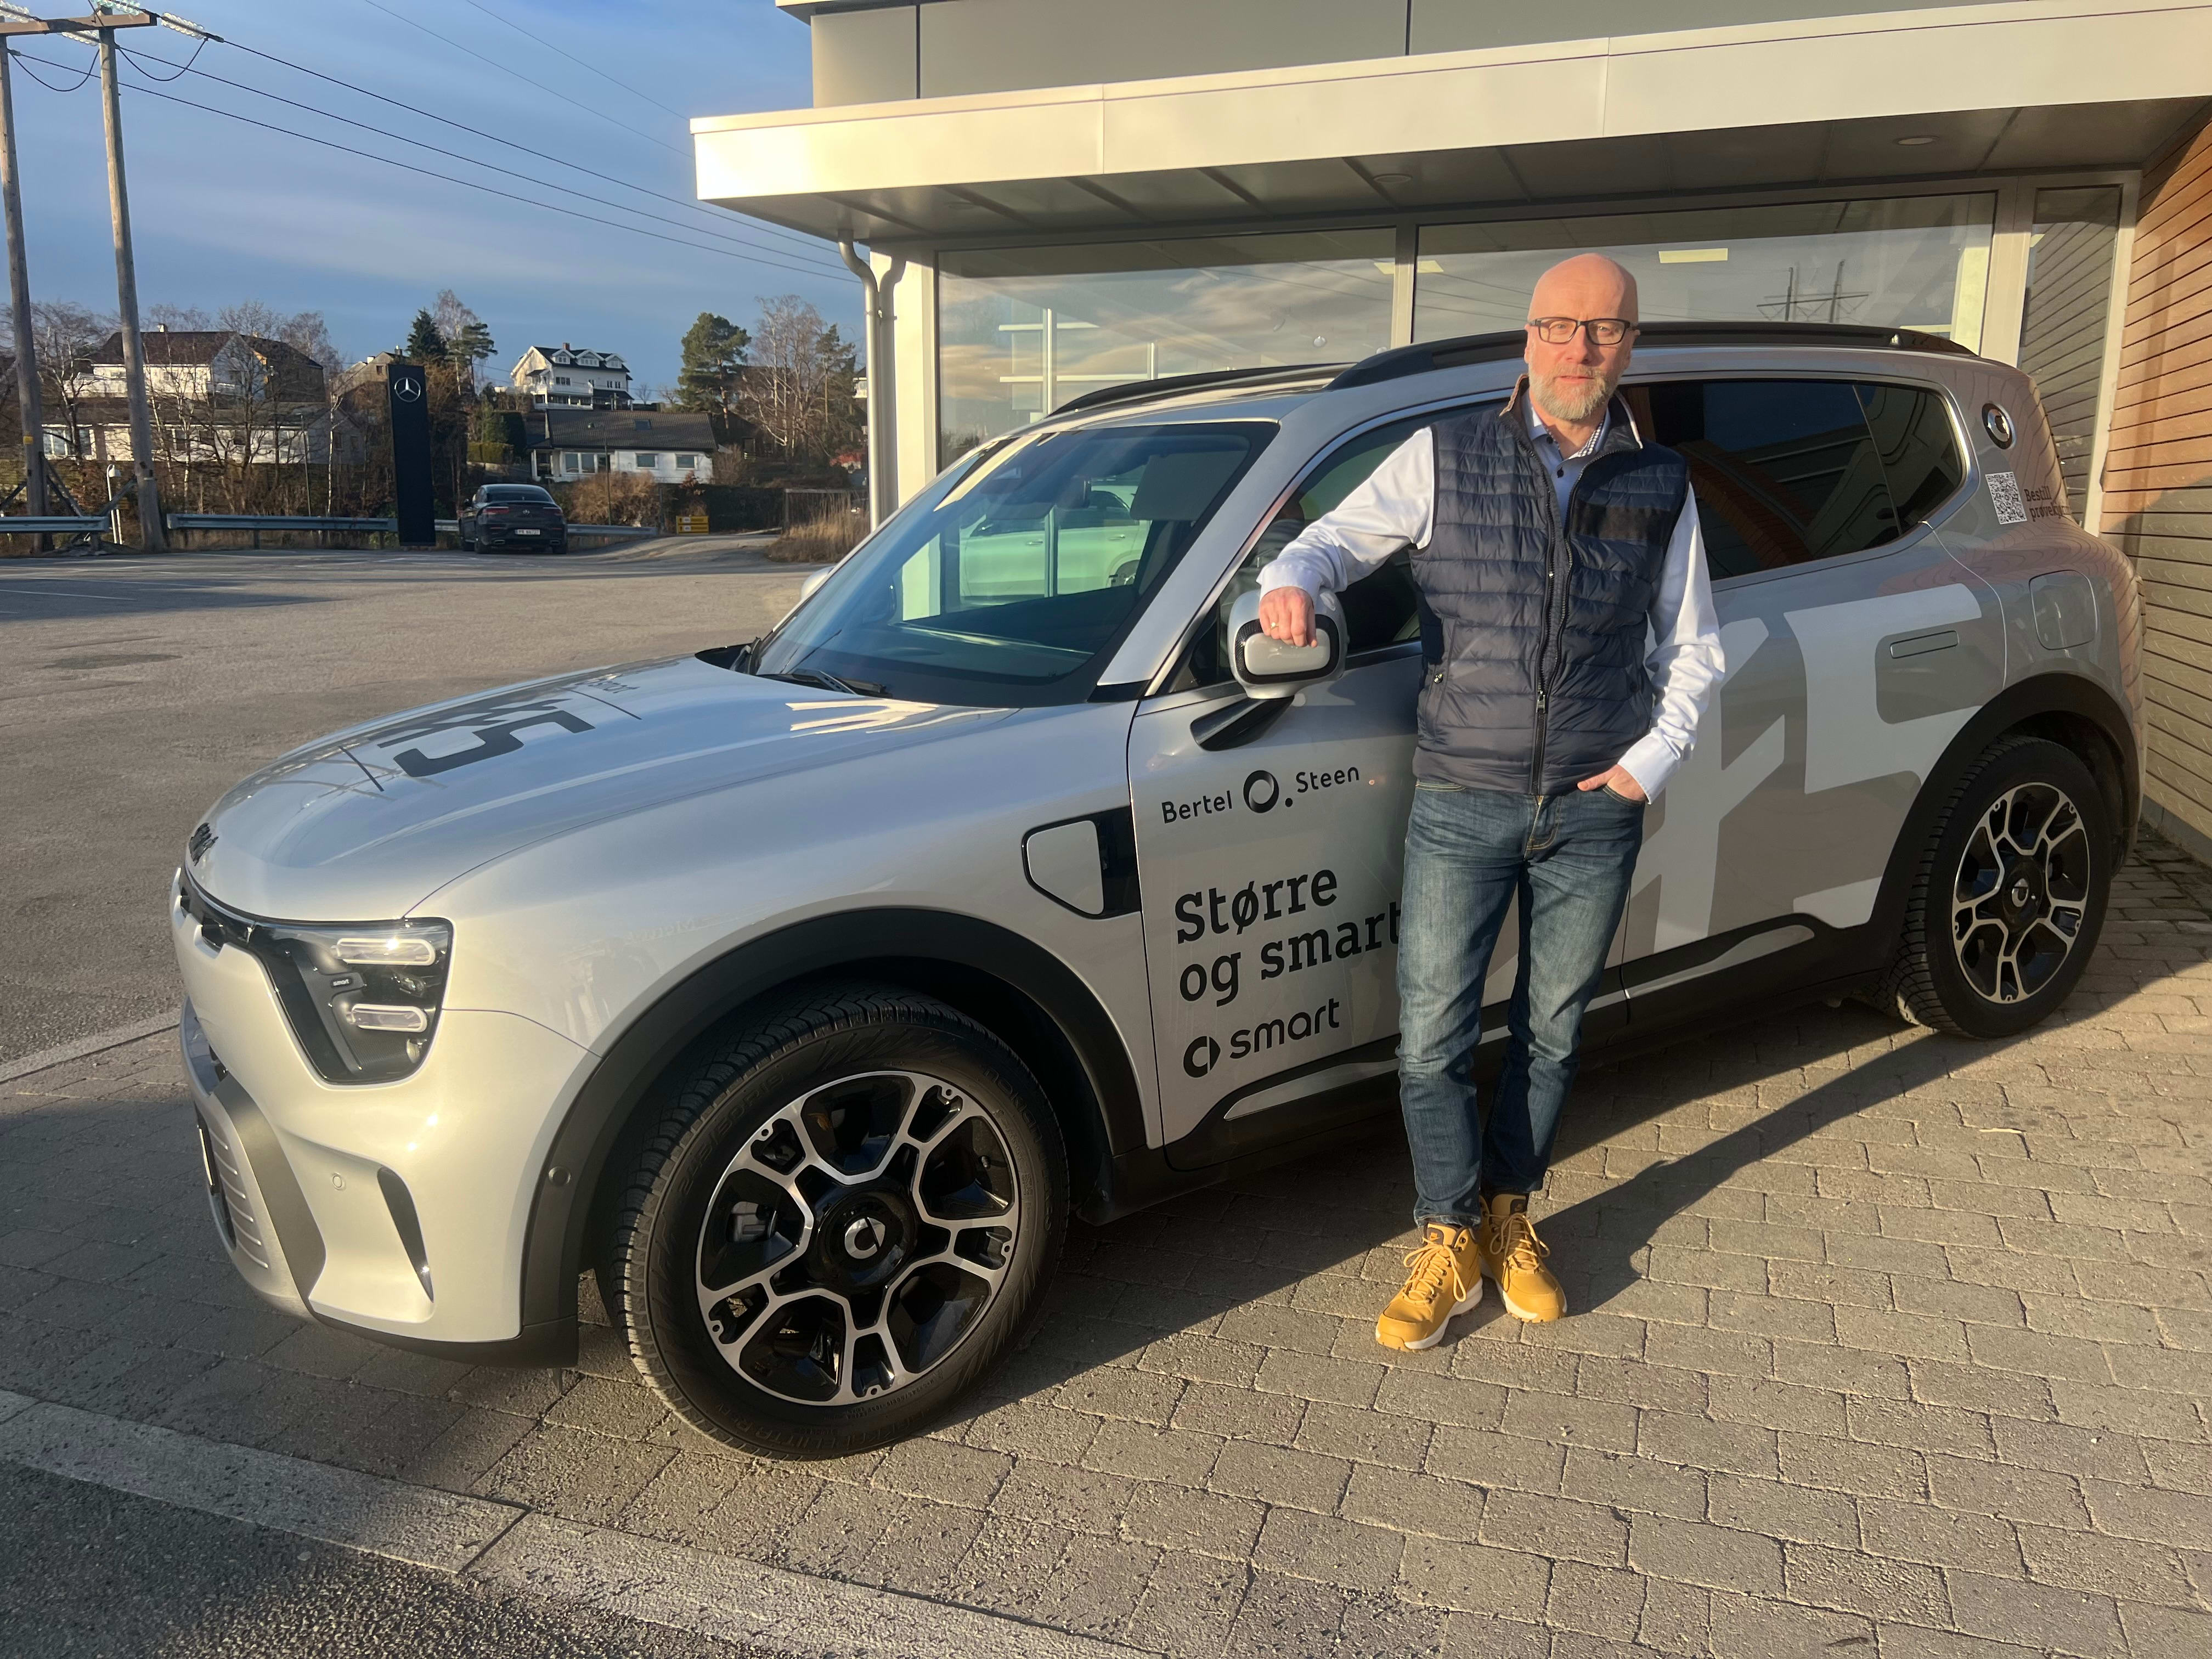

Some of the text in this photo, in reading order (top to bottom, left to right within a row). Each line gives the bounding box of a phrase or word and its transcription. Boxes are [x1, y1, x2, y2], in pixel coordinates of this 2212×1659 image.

[2024, 486, 2052, 501] Bestill
[1161, 790, 1232, 823] Bertel
[1296, 767, 1359, 793] Steen
[1175, 869, 1338, 944] Større
[1180, 901, 1401, 1007] og smart
[1229, 998, 1340, 1059] smart
[981, 1064, 1044, 1144] nokian
